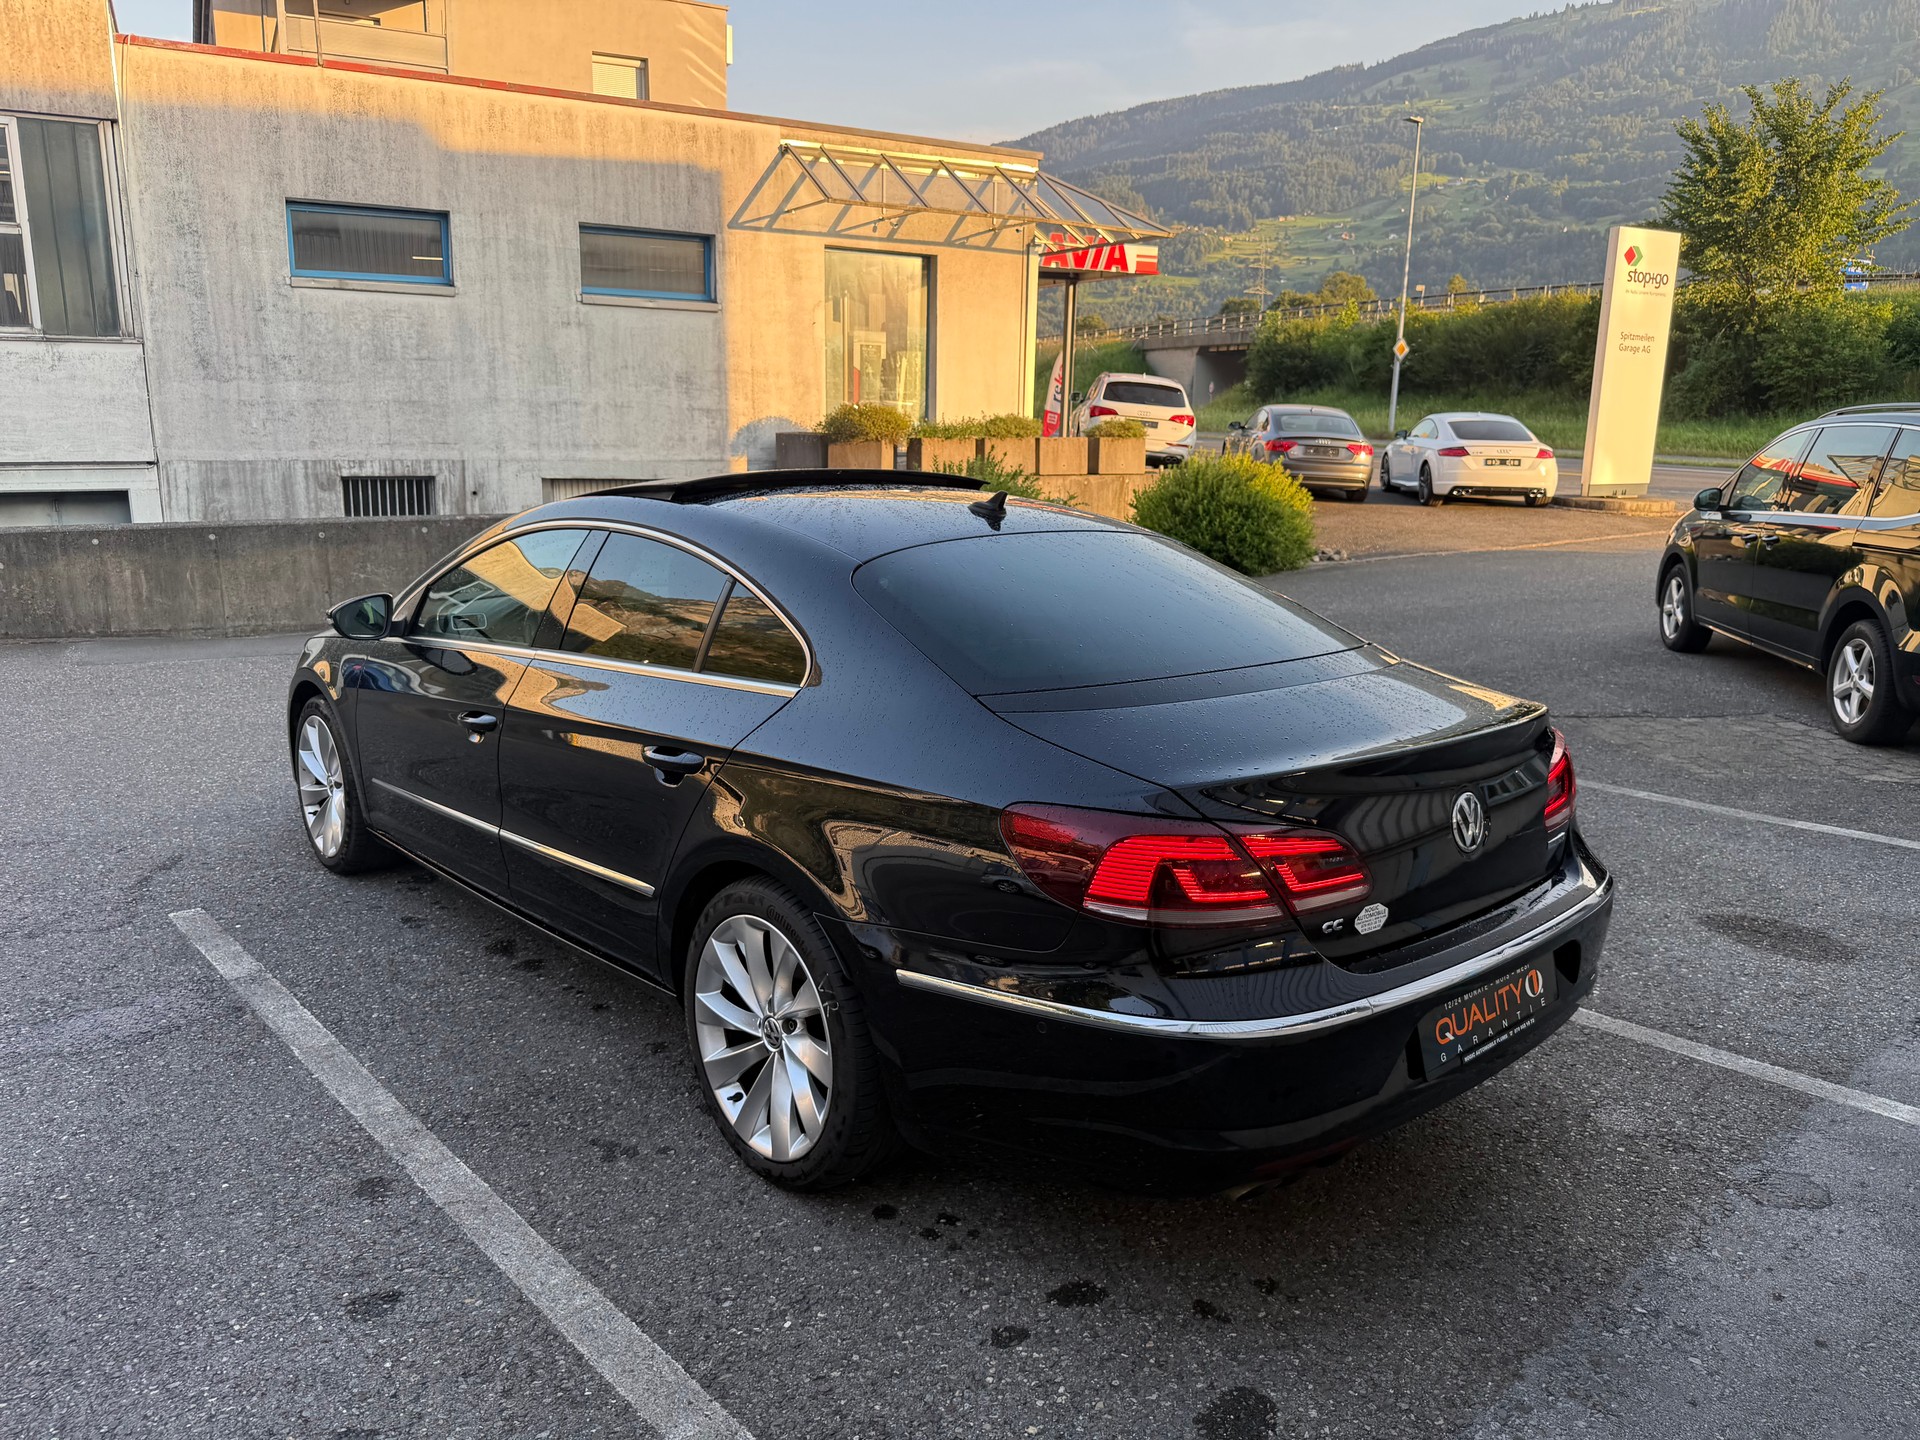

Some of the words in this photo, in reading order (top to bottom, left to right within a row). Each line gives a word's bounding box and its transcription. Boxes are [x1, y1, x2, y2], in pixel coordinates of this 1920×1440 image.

[1040, 232, 1129, 272] AVIA
[1627, 268, 1669, 289] stop+go
[1620, 331, 1655, 342] Spitzmeilen
[1618, 342, 1641, 355] Garage
[1641, 345, 1651, 354] AG
[1356, 908, 1387, 921] AUTOMOBILE
[1322, 918, 1344, 934] CC
[1436, 978, 1523, 1045] QUALITY
